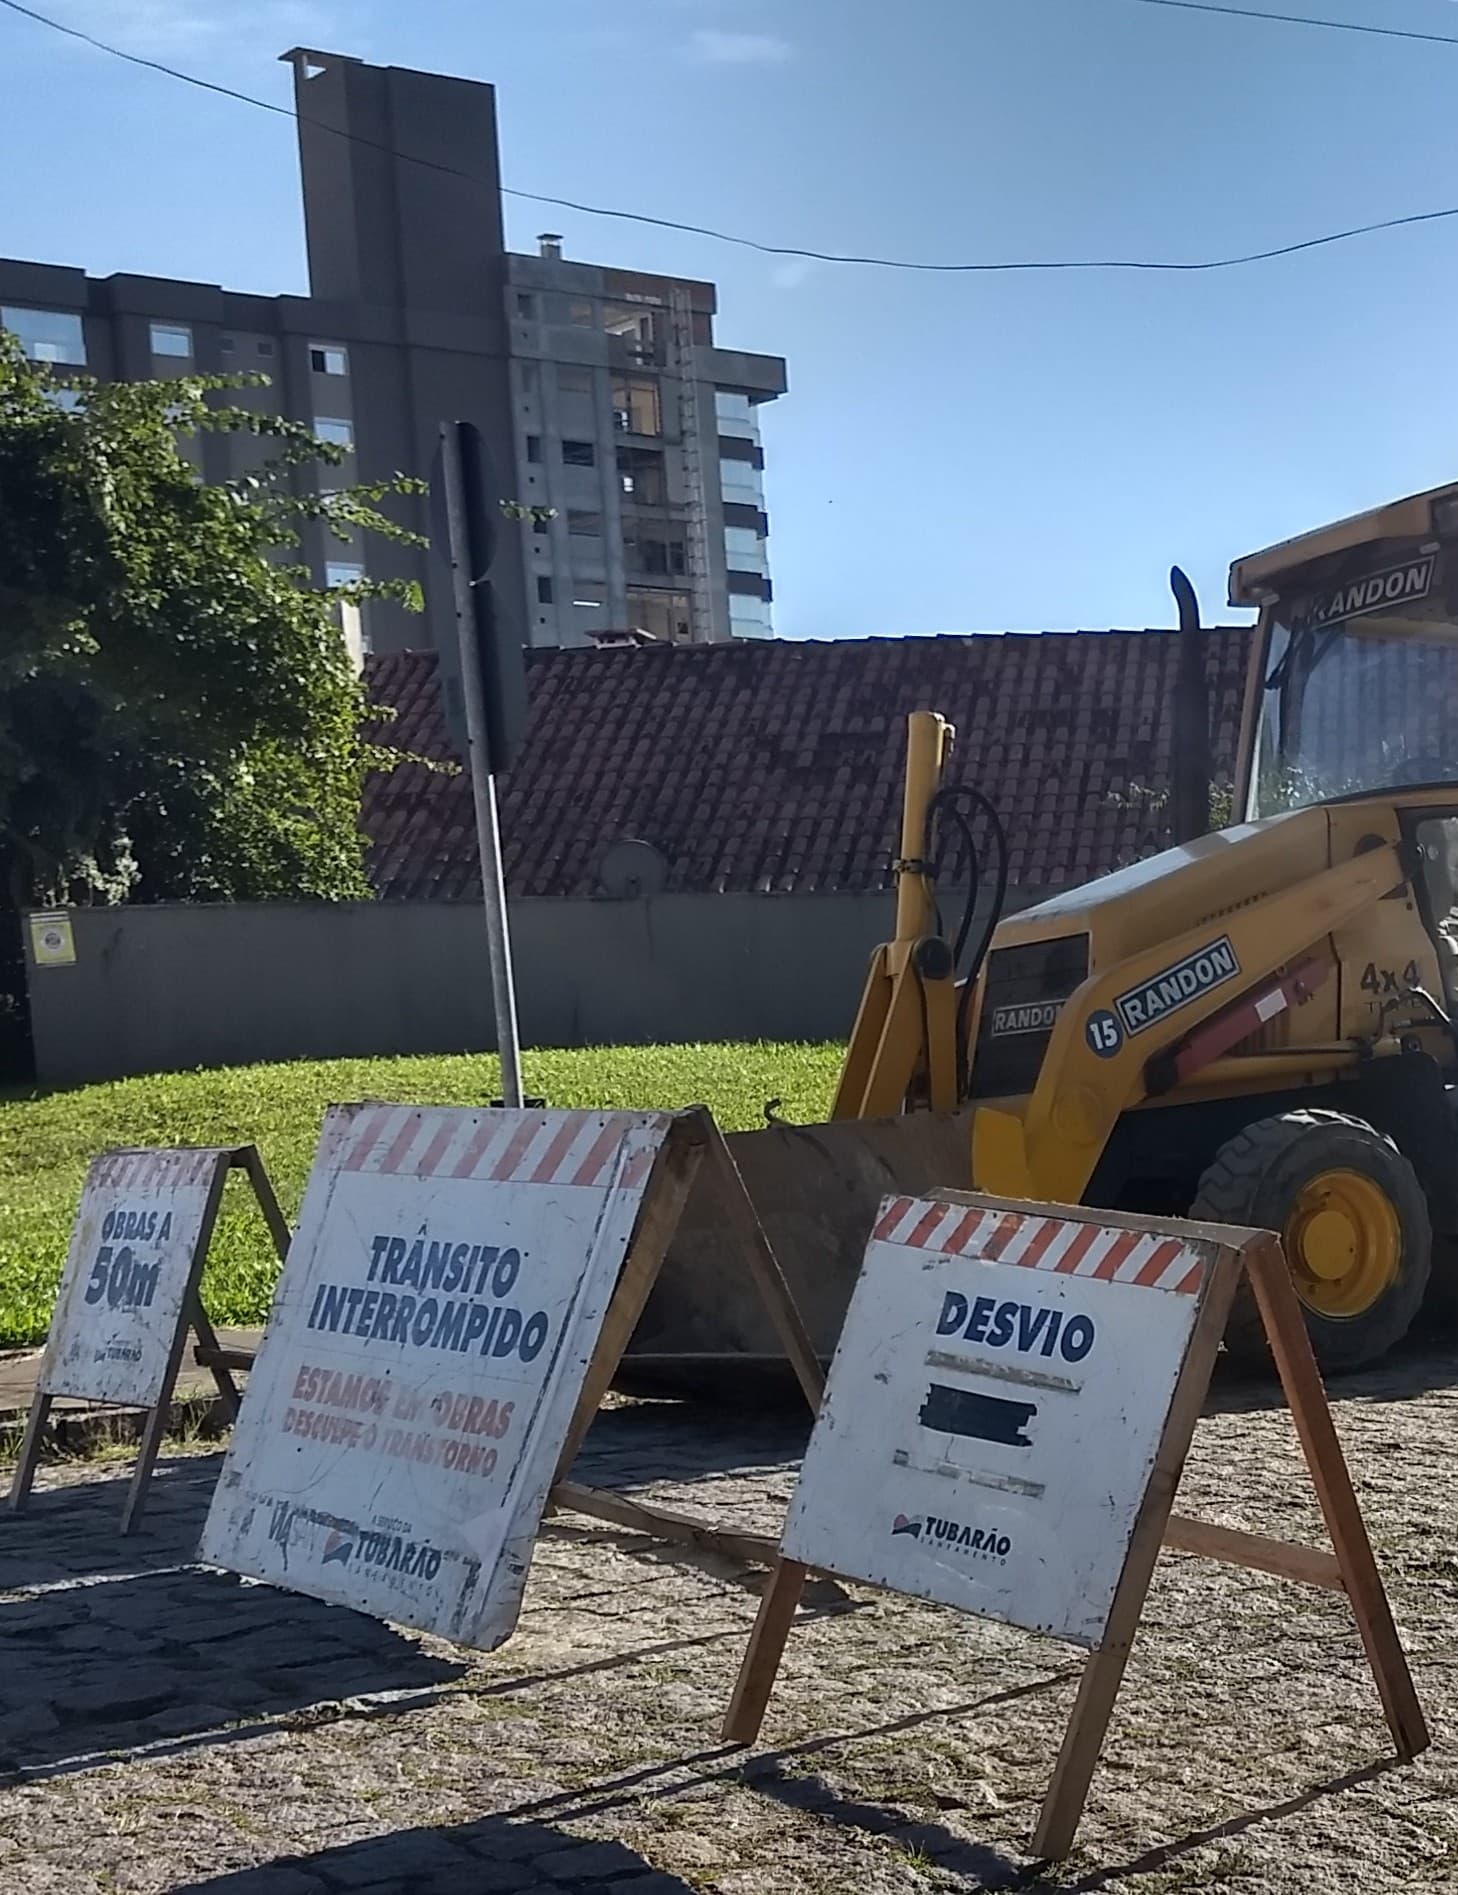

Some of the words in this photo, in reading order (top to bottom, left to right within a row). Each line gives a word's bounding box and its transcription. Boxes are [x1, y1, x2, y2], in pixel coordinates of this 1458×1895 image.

[1126, 945, 1234, 1027] RANDON
[1360, 960, 1421, 995] 4x4
[995, 1004, 1060, 1031] RANDO
[1089, 1018, 1118, 1050] 15
[102, 1210, 158, 1242] OBRAS
[157, 1211, 172, 1241] A
[85, 1246, 162, 1307] 50m
[367, 1224, 520, 1298] TRÂNSITO
[307, 1284, 548, 1363] INTERROMPIDO
[936, 1290, 1096, 1363] DESVIO
[432, 1391, 516, 1440] OBRAS
[355, 1531, 441, 1581] TUBARÃO
[925, 1516, 1011, 1556] TUBARÃO
